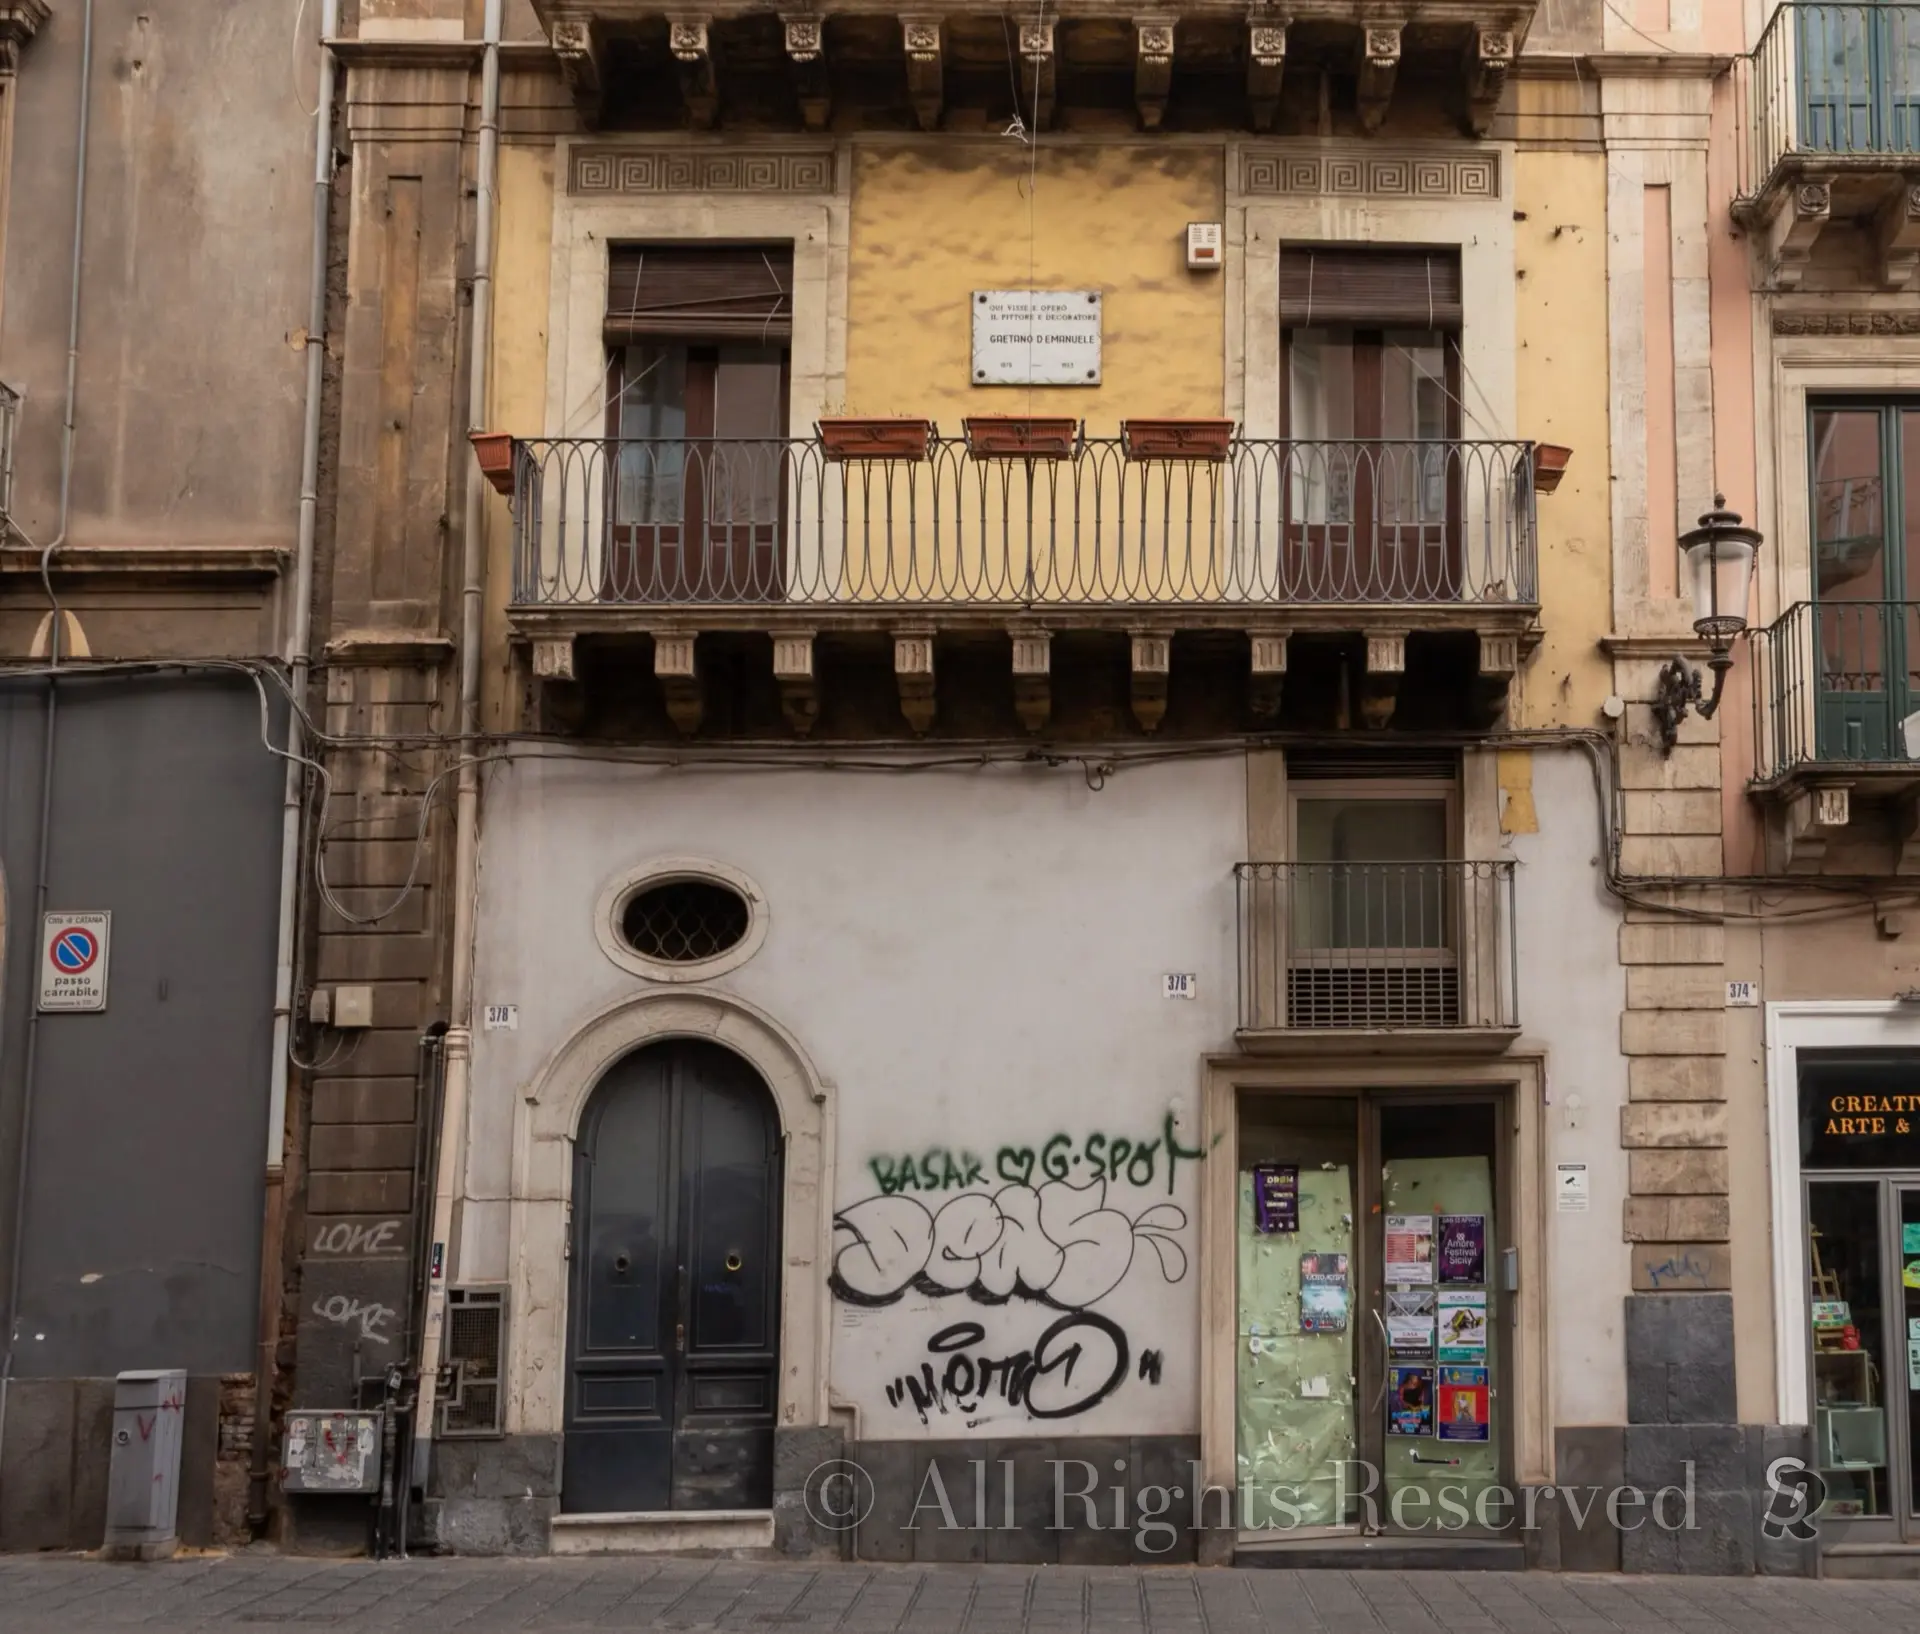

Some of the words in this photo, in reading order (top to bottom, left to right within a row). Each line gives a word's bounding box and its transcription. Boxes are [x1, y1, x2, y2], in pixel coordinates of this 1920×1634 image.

[990, 335, 1033, 344] GAETANO
[54, 977, 91, 987] passo
[1168, 975, 1187, 991] 376
[44, 987, 99, 997] carrabile
[1730, 983, 1749, 998] 374
[489, 1007, 508, 1022] 378
[1831, 1095, 1920, 1112] CREATI
[1825, 1117, 1885, 1134] ARTE
[1896, 1118, 1910, 1133] &
[1445, 1247, 1477, 1257] Festival
[1449, 1257, 1472, 1266] Sicily
